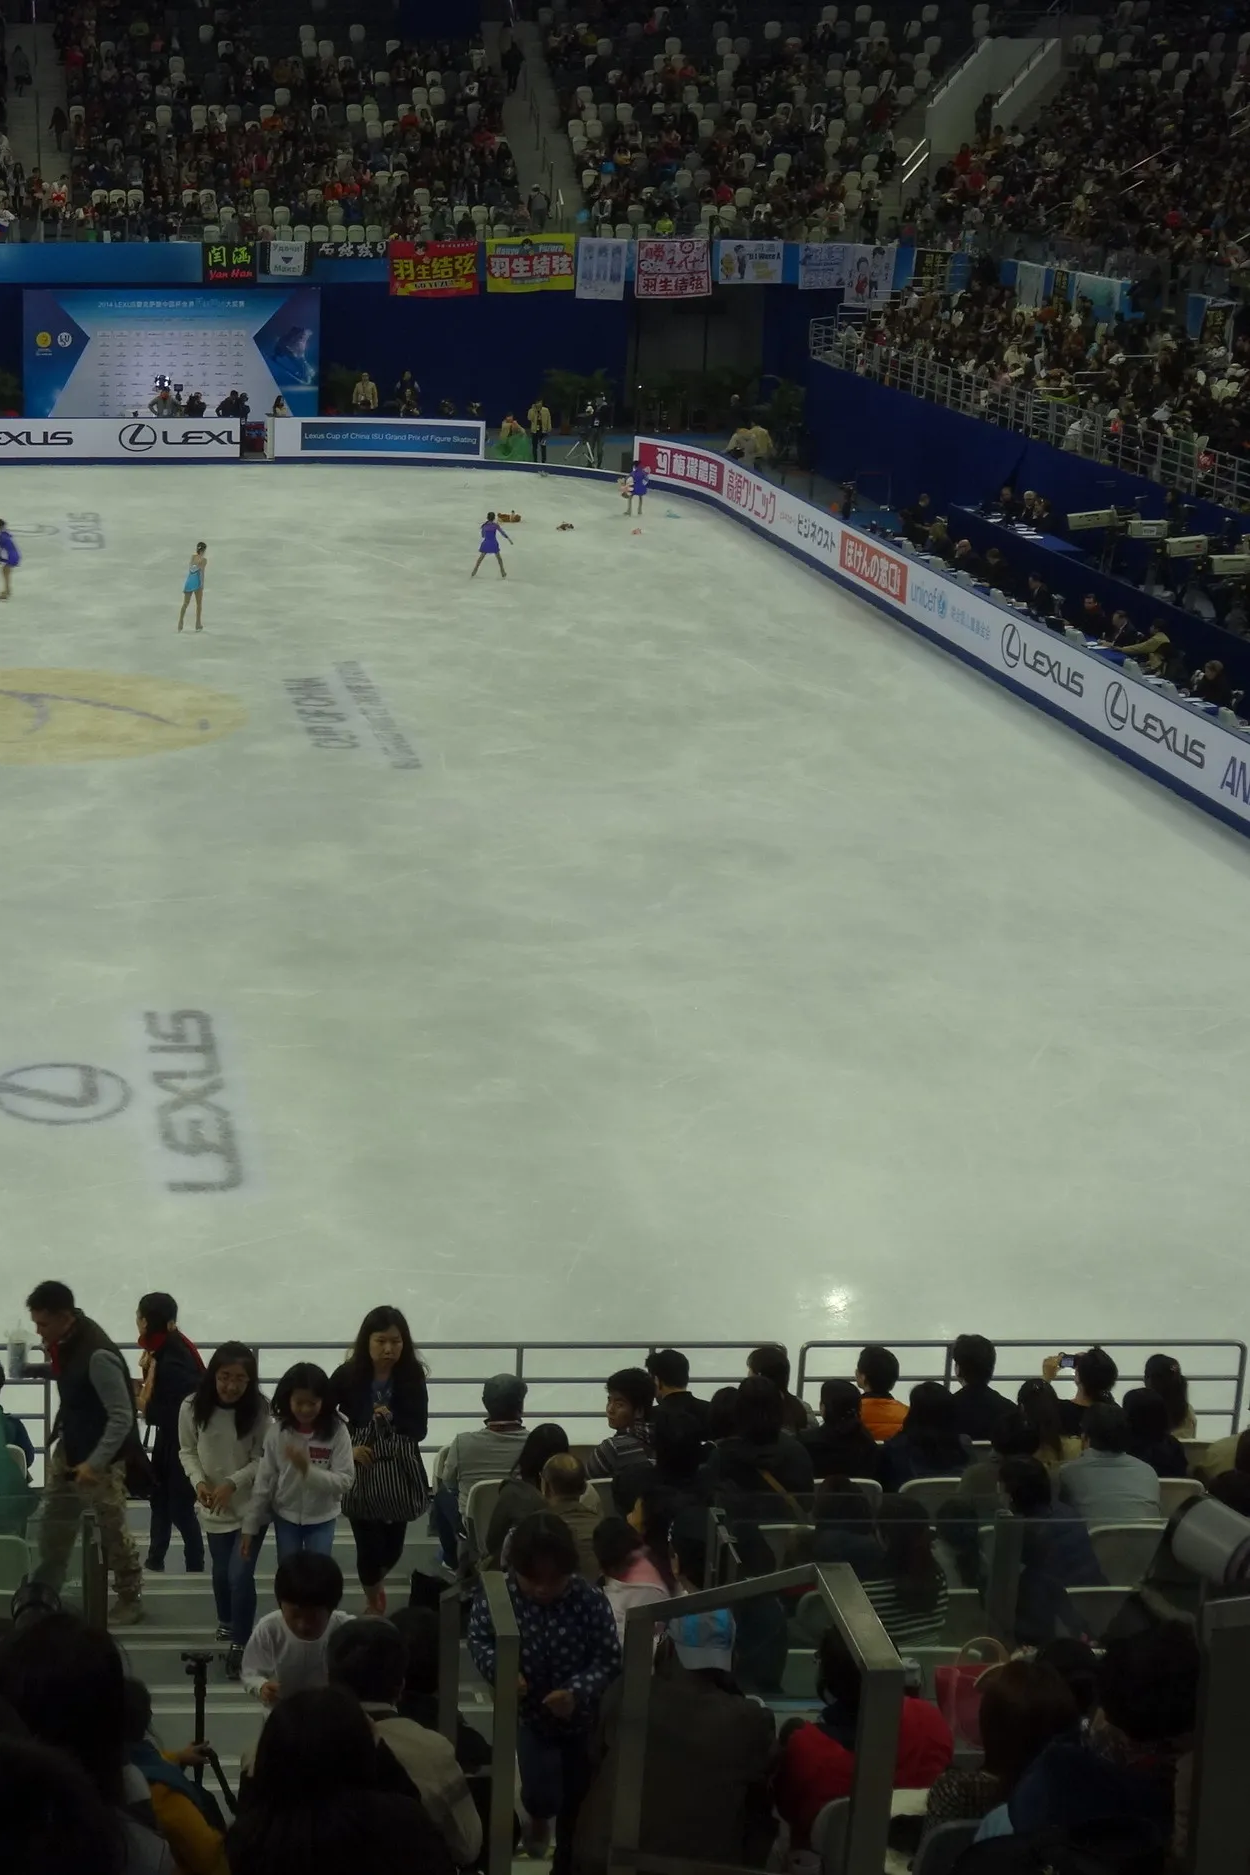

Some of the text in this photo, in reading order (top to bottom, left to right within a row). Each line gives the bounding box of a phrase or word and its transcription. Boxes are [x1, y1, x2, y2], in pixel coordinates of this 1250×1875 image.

[304, 432, 325, 440] Lexus
[326, 432, 341, 441] Cup
[342, 432, 349, 440] of
[350, 432, 370, 441] China
[385, 433, 407, 441] Grand
[408, 433, 421, 441] Prix
[422, 434, 429, 442] of
[429, 435, 452, 443] Figure
[453, 436, 477, 445] Skating
[726, 468, 777, 524] 高須クリニック
[66, 512, 106, 550] LEXUS
[797, 512, 836, 553] ビジネクスト
[911, 582, 938, 612] unicef
[1022, 642, 1084, 698] LEXUS
[1131, 703, 1206, 769] LEXUS
[143, 1009, 243, 1193] LEXUS
